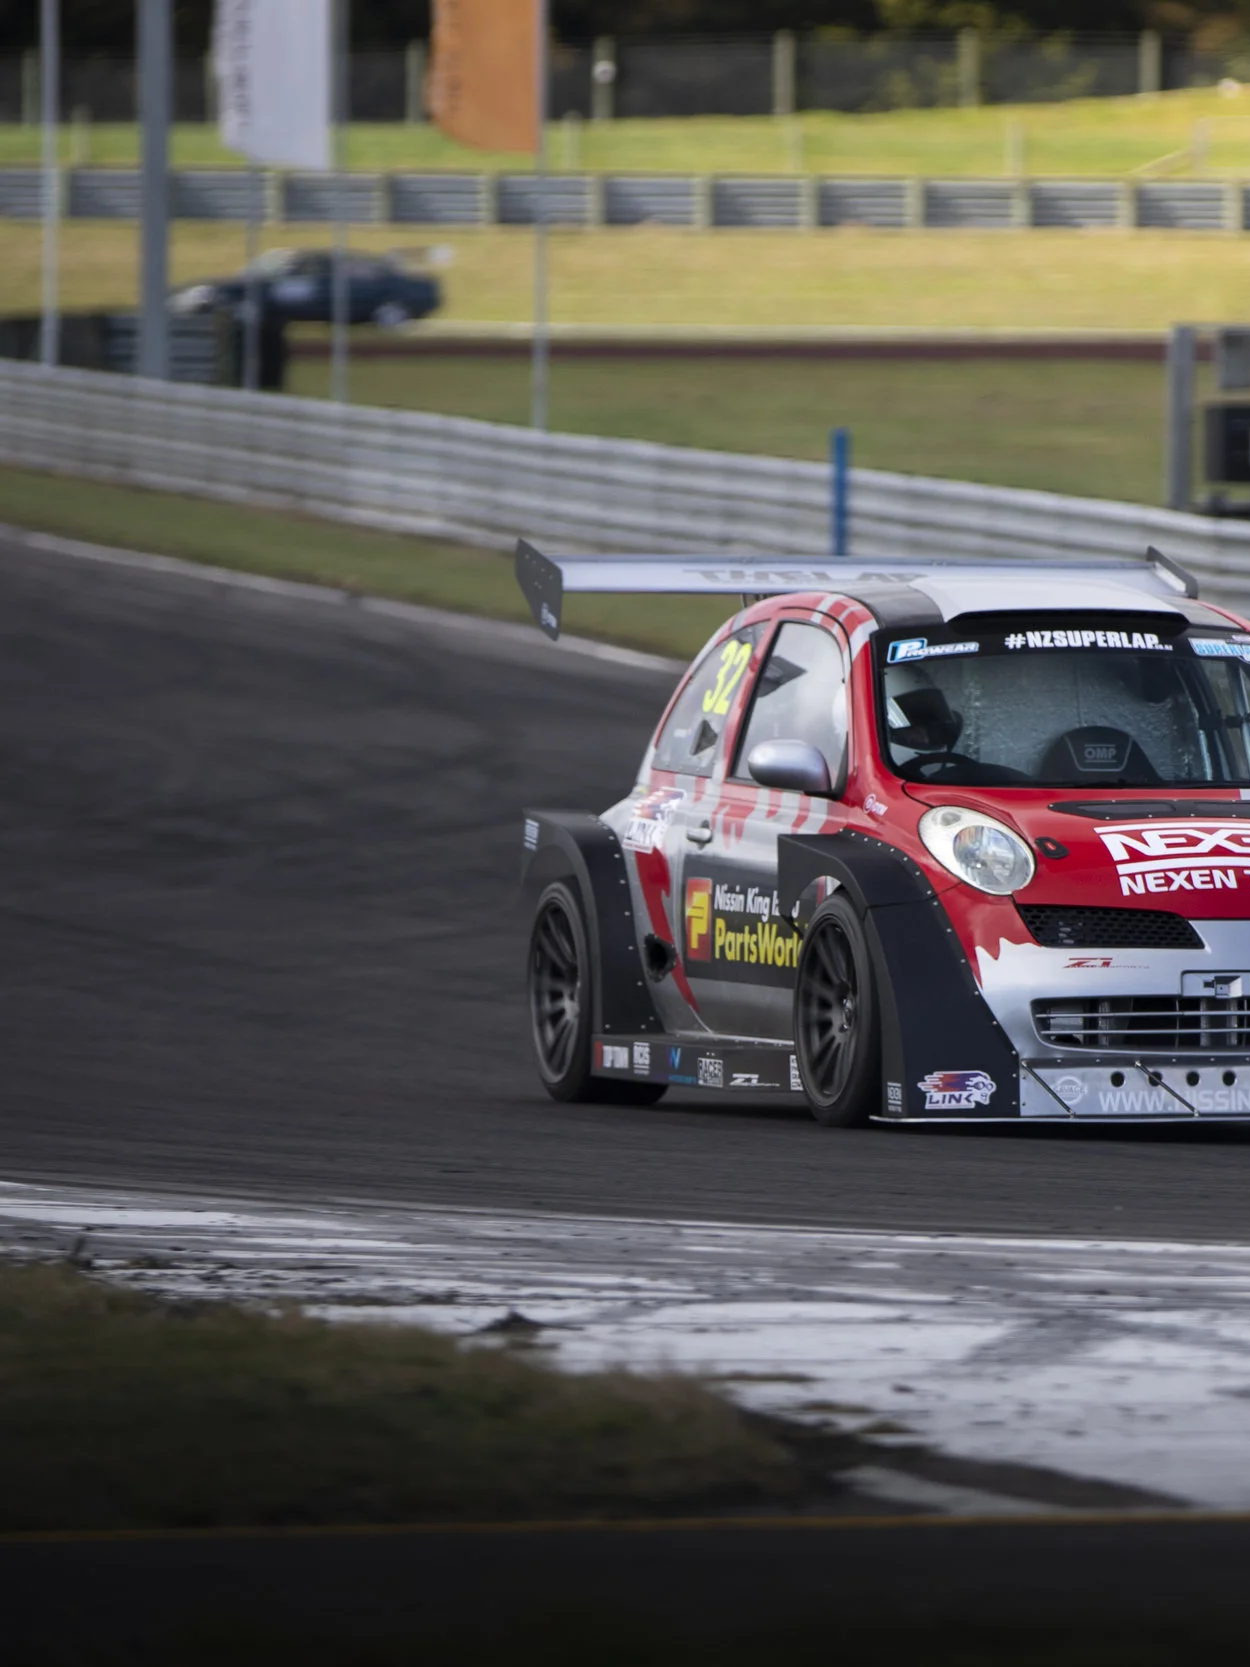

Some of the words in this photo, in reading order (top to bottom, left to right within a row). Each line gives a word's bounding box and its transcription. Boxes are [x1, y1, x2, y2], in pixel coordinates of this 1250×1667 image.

[893, 640, 977, 661] PROWEAR
[702, 639, 752, 715] 32
[1084, 747, 1117, 760] OMP
[1119, 869, 1238, 896] NEXEN
[714, 884, 745, 913] Nissin
[746, 887, 771, 922] King
[714, 918, 806, 968] PartsWorl
[928, 1092, 974, 1105] LINK
